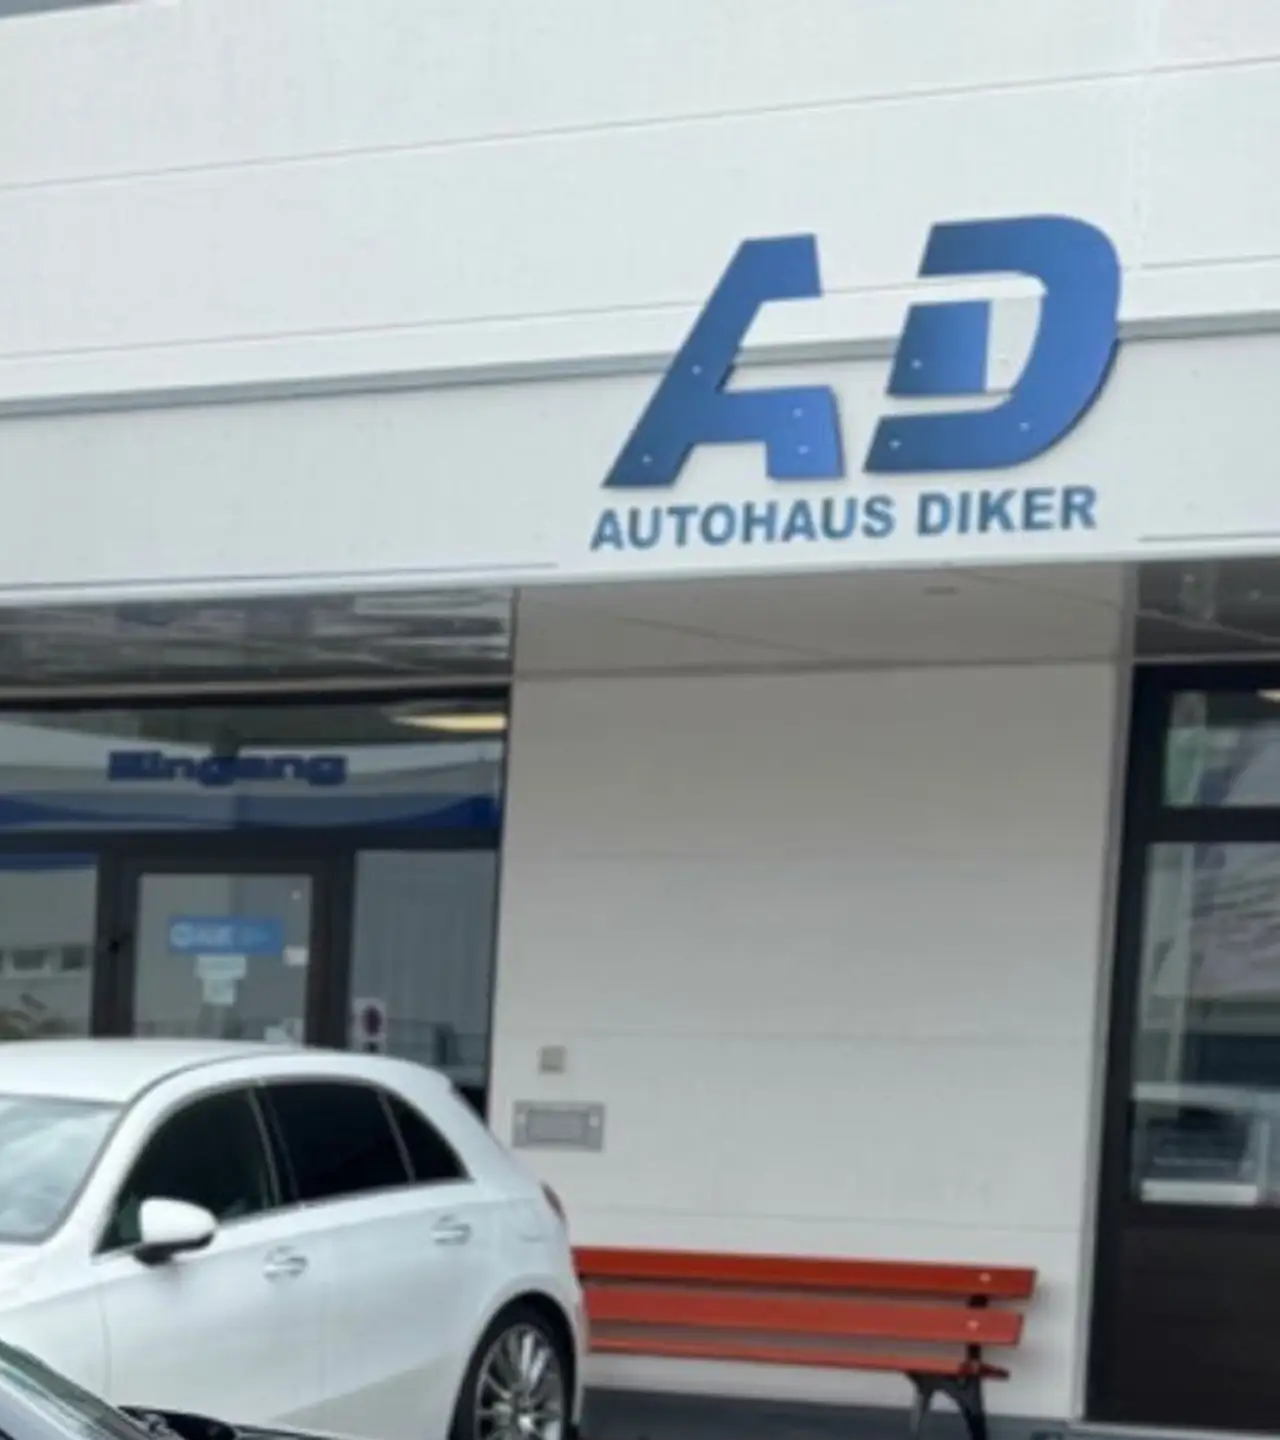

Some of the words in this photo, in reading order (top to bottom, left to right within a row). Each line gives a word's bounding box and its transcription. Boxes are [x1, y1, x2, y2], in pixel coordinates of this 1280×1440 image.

[603, 214, 1121, 488] AD
[590, 498, 895, 551] AUTOHAUS
[916, 486, 1097, 536] DIKER
